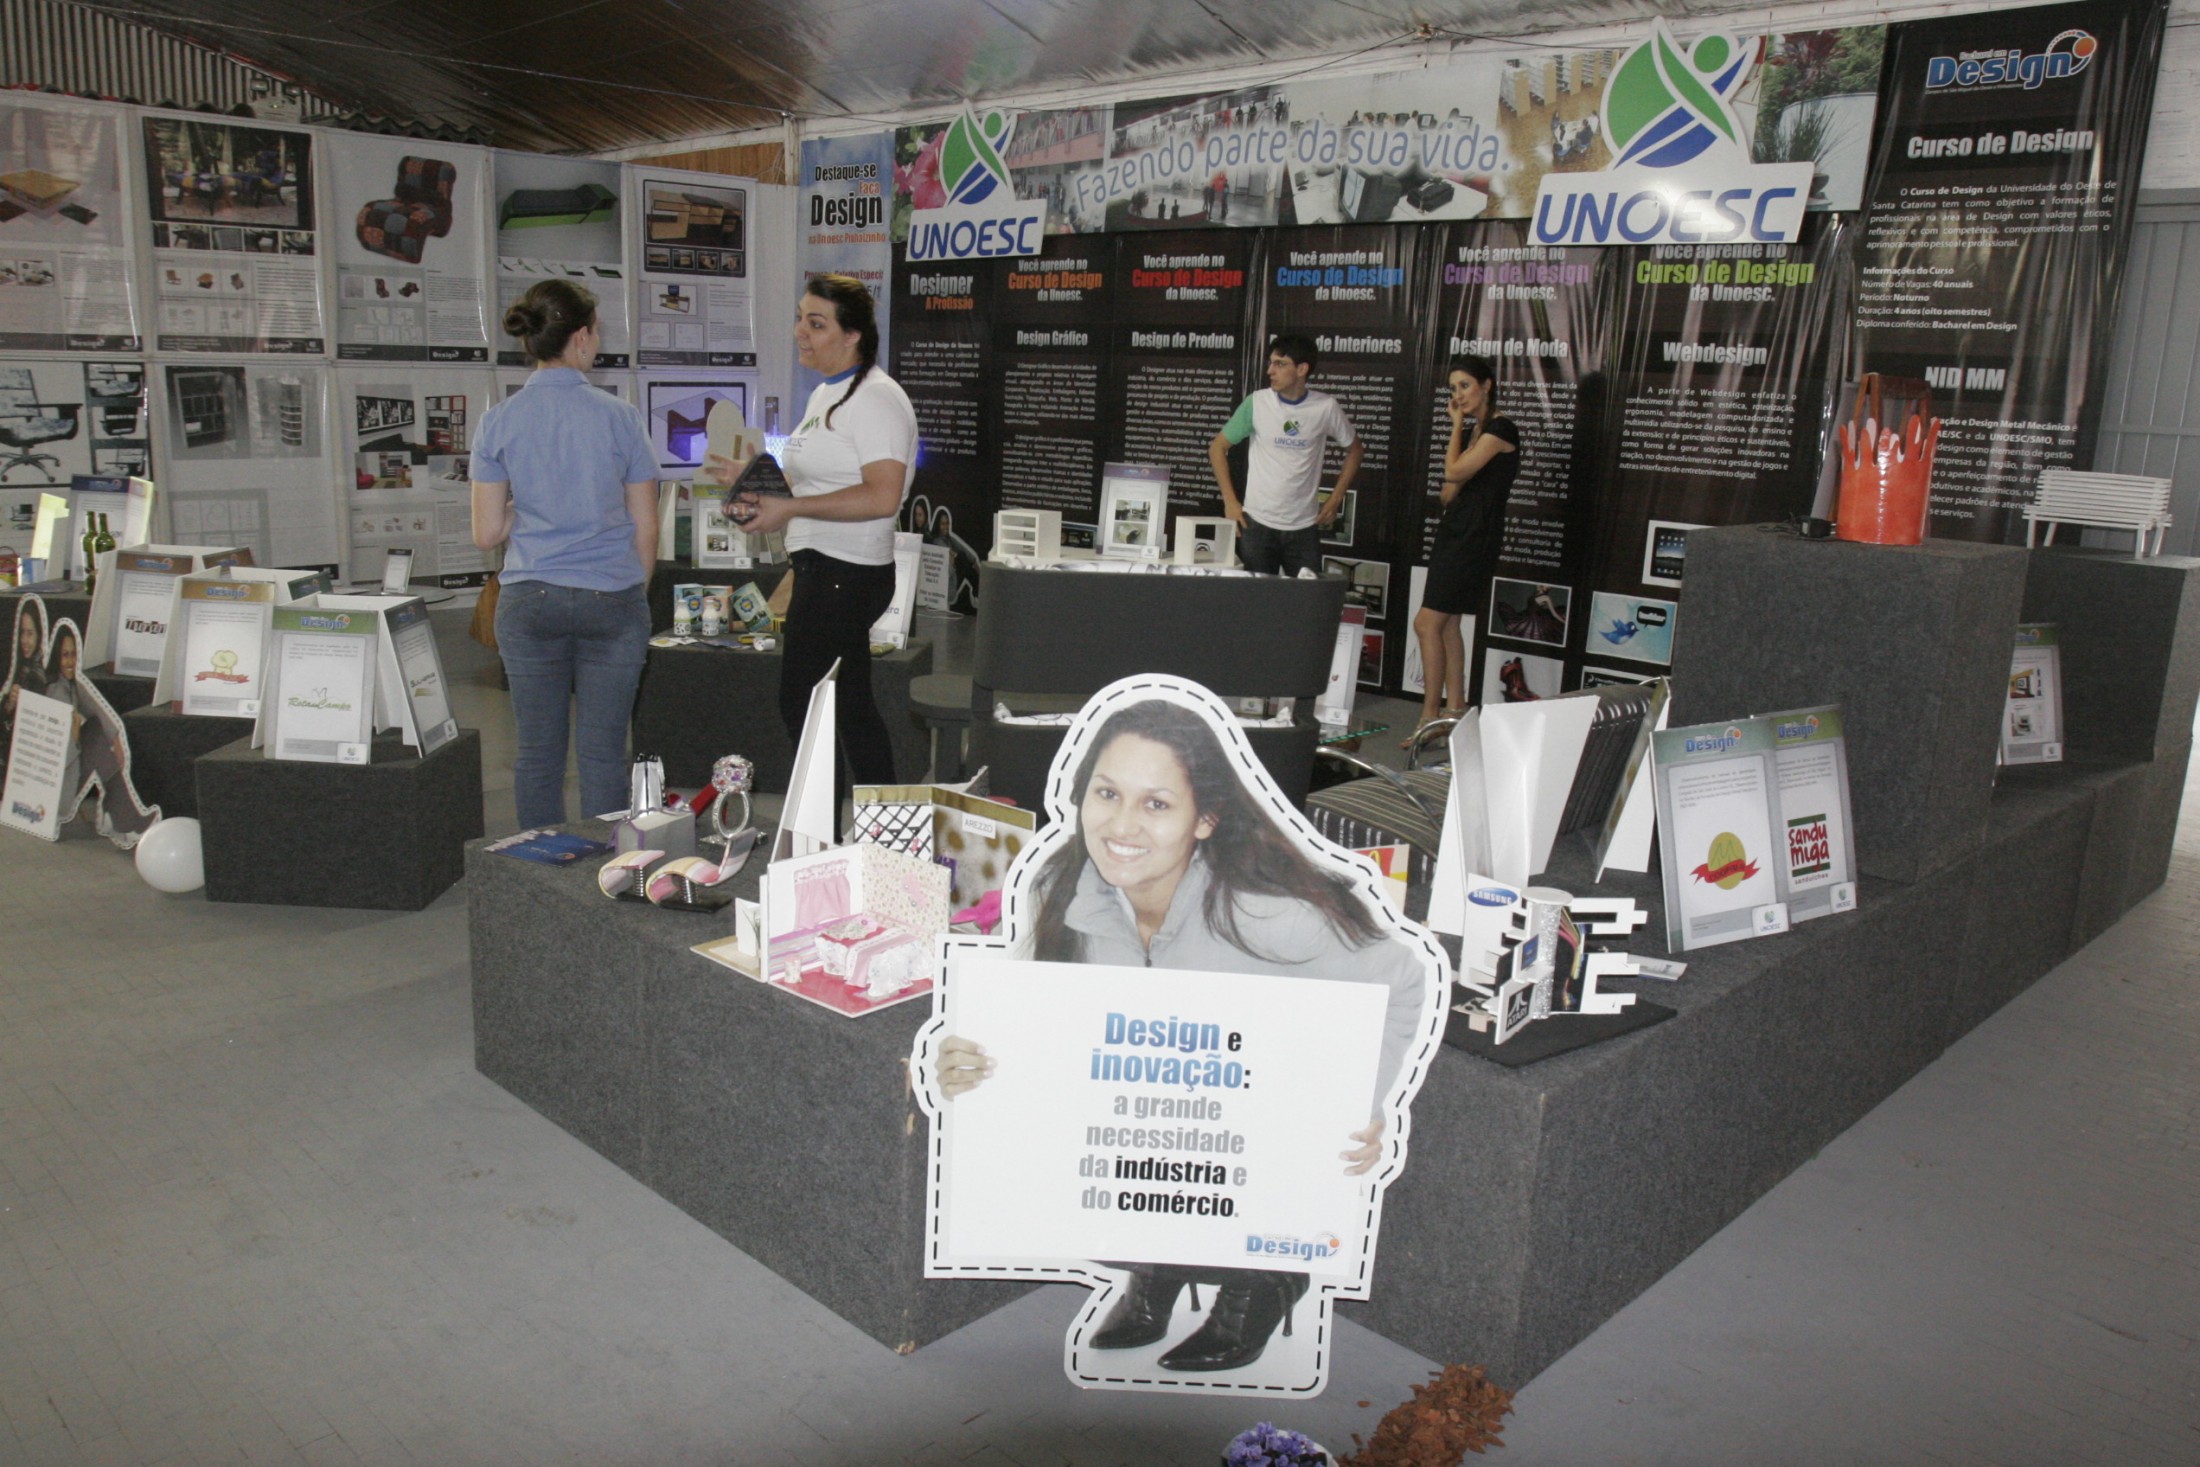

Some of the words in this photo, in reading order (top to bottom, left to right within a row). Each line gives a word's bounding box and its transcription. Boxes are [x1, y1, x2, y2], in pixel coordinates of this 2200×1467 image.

[1926, 50, 2072, 90] Design
[1907, 137, 1972, 159] Curso
[1977, 132, 2006, 155] de
[2010, 128, 2094, 154] Design
[815, 164, 876, 181] Destaque-se
[1076, 135, 1195, 211] Fazendo
[1204, 128, 1287, 177] parte
[1299, 120, 1338, 164] da
[1347, 130, 1407, 167] sua
[1421, 122, 1509, 172] vida.
[1900, 188, 1908, 196] O
[1910, 187, 1936, 196] Curso
[1938, 186, 1949, 194] de
[1952, 186, 1984, 196] Design
[1986, 185, 1998, 194] da
[2000, 183, 2057, 192] Universidade
[2060, 182, 2073, 190] do
[2104, 180, 2117, 189] de
[811, 193, 882, 228] Design
[1872, 201, 1896, 210] Santa
[1900, 200, 1936, 210] Catarina
[1942, 200, 1960, 208] tem
[1965, 200, 1990, 208] como
[1996, 198, 2034, 208] objetivo
[2102, 194, 2114, 203] de
[1536, 187, 1797, 244] UNOESC
[910, 216, 1038, 260] UNOESC
[1290, 250, 1316, 266] Você
[1318, 250, 1366, 267] aprende
[1368, 251, 1384, 264] no
[1458, 246, 1490, 262] Você
[1492, 245, 1546, 263] aprende
[1548, 246, 1566, 260] no
[1766, 244, 1787, 259] no
[1018, 259, 1039, 272] Você
[1040, 258, 1075, 272] aprende
[1076, 258, 1088, 270] no
[1144, 254, 1167, 268] Você
[1168, 253, 1210, 270] aprende
[1212, 254, 1225, 267] no
[1863, 266, 1916, 276] Informações
[1917, 267, 1928, 275] do
[1929, 267, 1954, 275] Curso
[1008, 272, 1042, 290] Curso
[1044, 272, 1060, 289] de
[1062, 270, 1102, 290] Design
[1132, 268, 1172, 288] Curso
[1174, 268, 1190, 287] de
[1194, 268, 1243, 288] Design
[1277, 266, 1321, 286] Curso
[1324, 266, 1344, 286] de
[1346, 264, 1404, 288] Design
[1444, 263, 1494, 284] Curso
[1499, 262, 1522, 284] de
[1525, 261, 1589, 286] Design
[1636, 260, 1698, 284] Curso
[1703, 260, 1731, 284] de
[1734, 260, 1815, 287] Design
[910, 273, 974, 297] Designer
[1166, 286, 1178, 300] da
[1180, 286, 1219, 300] Unoesc.
[1315, 286, 1330, 301] da
[1332, 286, 1376, 300] Unoesc.
[1488, 284, 1504, 300] da
[1506, 284, 1558, 300] Unoesc.
[1690, 284, 1710, 302] da
[1712, 284, 1776, 302] Unoesc.
[1862, 280, 1894, 288] Número
[1894, 280, 1906, 288] de
[1932, 280, 1944, 288] 40
[1944, 280, 1974, 288] anuais
[1037, 289, 1048, 302] da
[1050, 289, 1083, 301] Unoesc.
[1893, 294, 1930, 302] Noturno
[1922, 307, 1942, 316] (oito
[1943, 308, 1991, 316] semestres)
[1856, 319, 1890, 330] Diploma
[1932, 320, 1970, 330] Bacharel
[1971, 322, 1985, 330] em
[1986, 322, 2018, 332] Design
[1016, 330, 1050, 347] Design
[1052, 330, 1088, 346] Gráfico
[1132, 331, 1170, 350] Design
[1172, 332, 1187, 348] de
[1188, 332, 1235, 350] Produto
[1316, 335, 1332, 352] de
[1334, 335, 1402, 354] Interiores
[1450, 336, 1500, 358] Design
[1504, 338, 1524, 357] de
[1526, 338, 1568, 358] Moda
[1662, 341, 1768, 366] Webdesign
[1965, 368, 2006, 391] MM
[1700, 388, 1746, 400] Webdesign
[1968, 418, 1999, 430] Design
[2000, 420, 2026, 430] Metal
[1778, 722, 1814, 738] Design
[1685, 735, 1734, 752] Design
[1788, 820, 1828, 846] sandu
[1790, 839, 1830, 872] miga
[1472, 890, 1512, 905] SAMSUNG
[1507, 1004, 1528, 1028] ATARI
[1104, 1012, 1220, 1053] Design
[1227, 1031, 1242, 1052] e
[1090, 1048, 1252, 1092] inovação:
[1114, 1095, 1128, 1116] a
[1134, 1096, 1222, 1121] grande
[1086, 1126, 1246, 1155] necessidade
[1079, 1154, 1109, 1179] da
[1114, 1156, 1227, 1186] indústria
[1232, 1166, 1248, 1187] e
[1081, 1186, 1112, 1211] do
[1117, 1190, 1239, 1218] comércio.
[1246, 1235, 1328, 1262] Design
